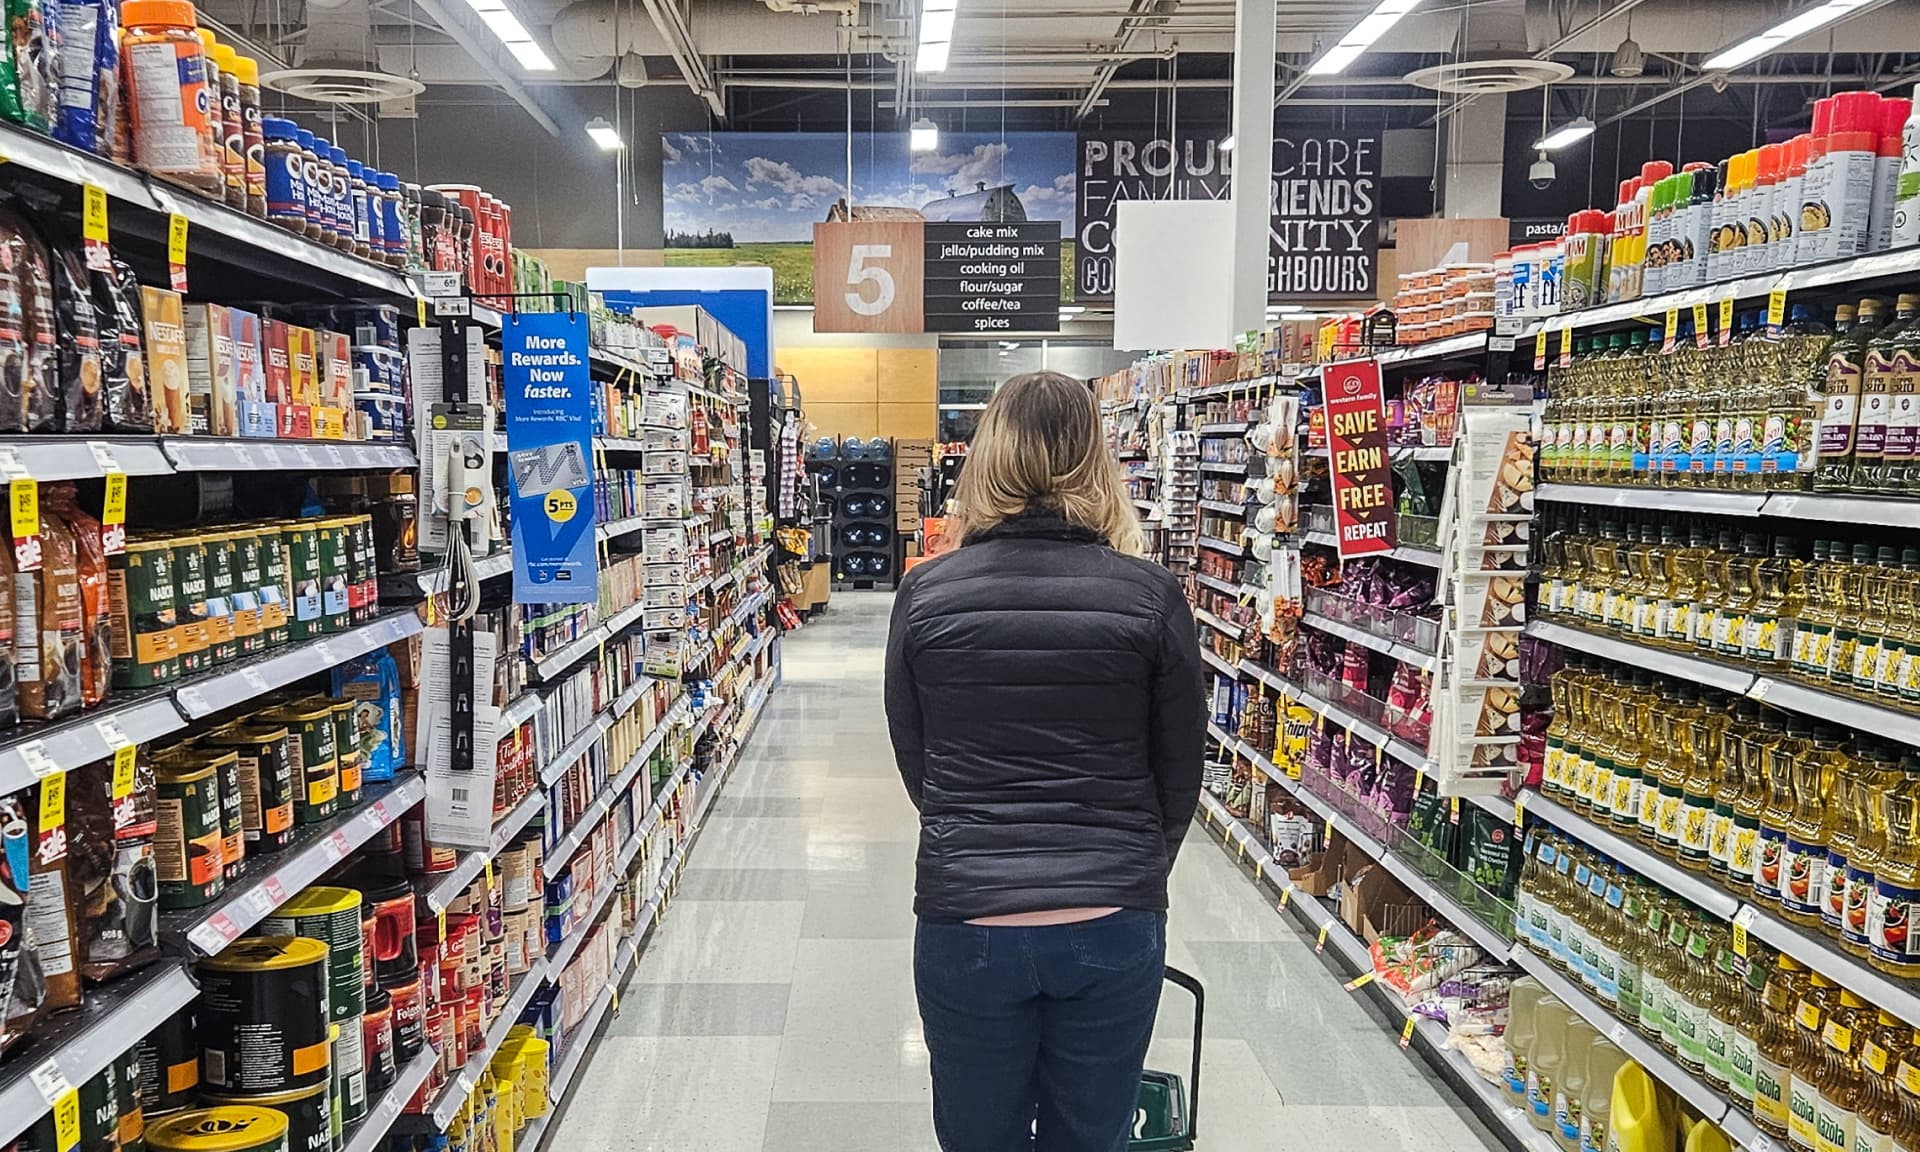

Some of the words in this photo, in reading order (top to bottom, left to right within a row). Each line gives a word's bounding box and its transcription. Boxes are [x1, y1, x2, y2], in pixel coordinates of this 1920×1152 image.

[1084, 139, 1232, 177] PROU
[1271, 179, 1373, 215] RIENDS
[966, 226, 993, 238] cake
[996, 226, 1018, 238] mix
[940, 244, 1019, 259] jello/pudding
[1023, 245, 1045, 256] mix
[960, 262, 1007, 276] cooking
[1010, 262, 1024, 274] oil
[844, 244, 895, 316] 5
[960, 281, 1023, 294] flour/sugar
[961, 299, 1021, 310] coffee/tea
[974, 318, 1010, 329] spices
[525, 335, 566, 349] More
[511, 351, 581, 366] Rewards.
[530, 368, 564, 382] Now
[524, 384, 572, 398] faster.
[1330, 396, 1355, 405] western
[1356, 392, 1377, 402] family
[1333, 409, 1378, 437] SAVE
[1336, 447, 1382, 474] EARN
[1340, 484, 1385, 510] FREE
[548, 499, 559, 513] 5
[1343, 521, 1388, 541] REPEAT
[1756, 1071, 1781, 1102] azola
[1791, 1091, 1814, 1123] azola
[1818, 1113, 1845, 1147] azola
